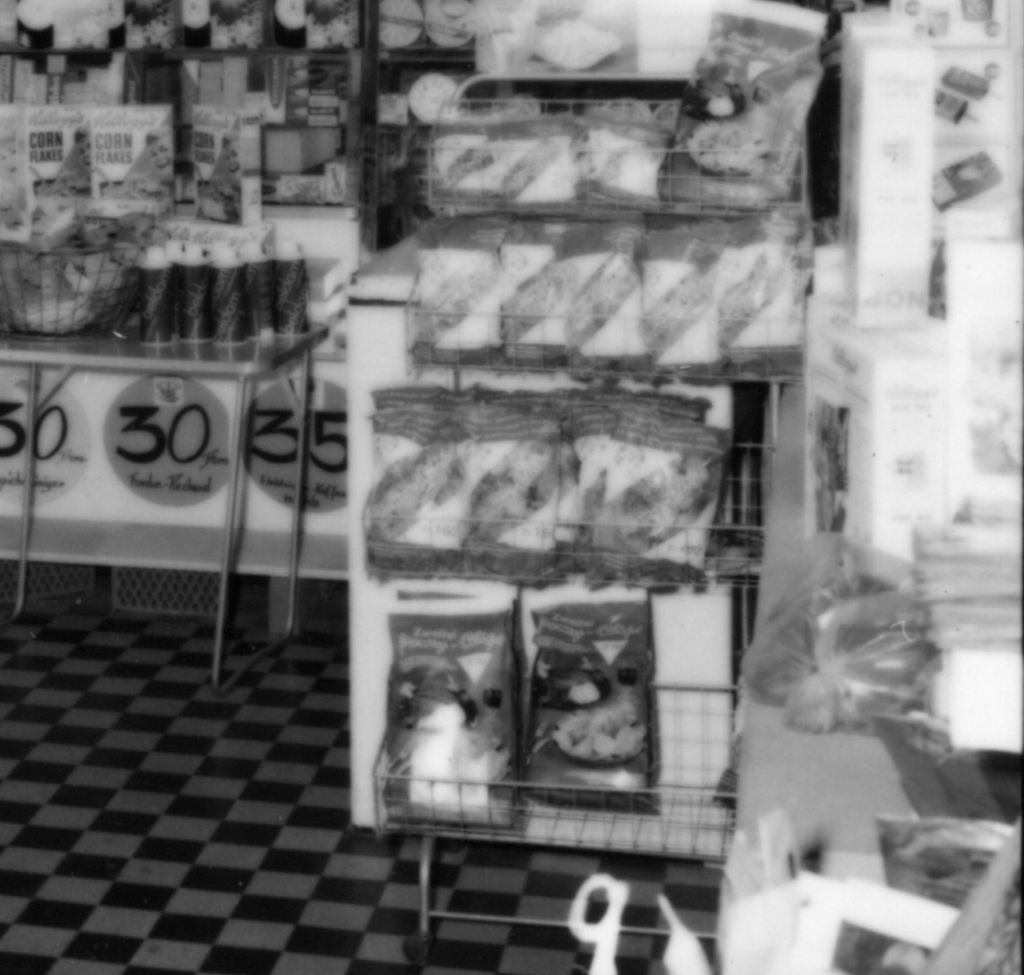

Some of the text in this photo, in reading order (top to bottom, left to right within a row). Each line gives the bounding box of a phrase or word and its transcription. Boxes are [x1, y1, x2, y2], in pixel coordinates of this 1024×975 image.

[29, 130, 64, 149] CORN
[94, 132, 133, 151] CORN
[194, 130, 215, 149] CORN
[29, 149, 64, 164] FLAKES
[94, 150, 133, 165] FLAKES
[115, 404, 211, 465] 30
[251, 409, 348, 474] 35
